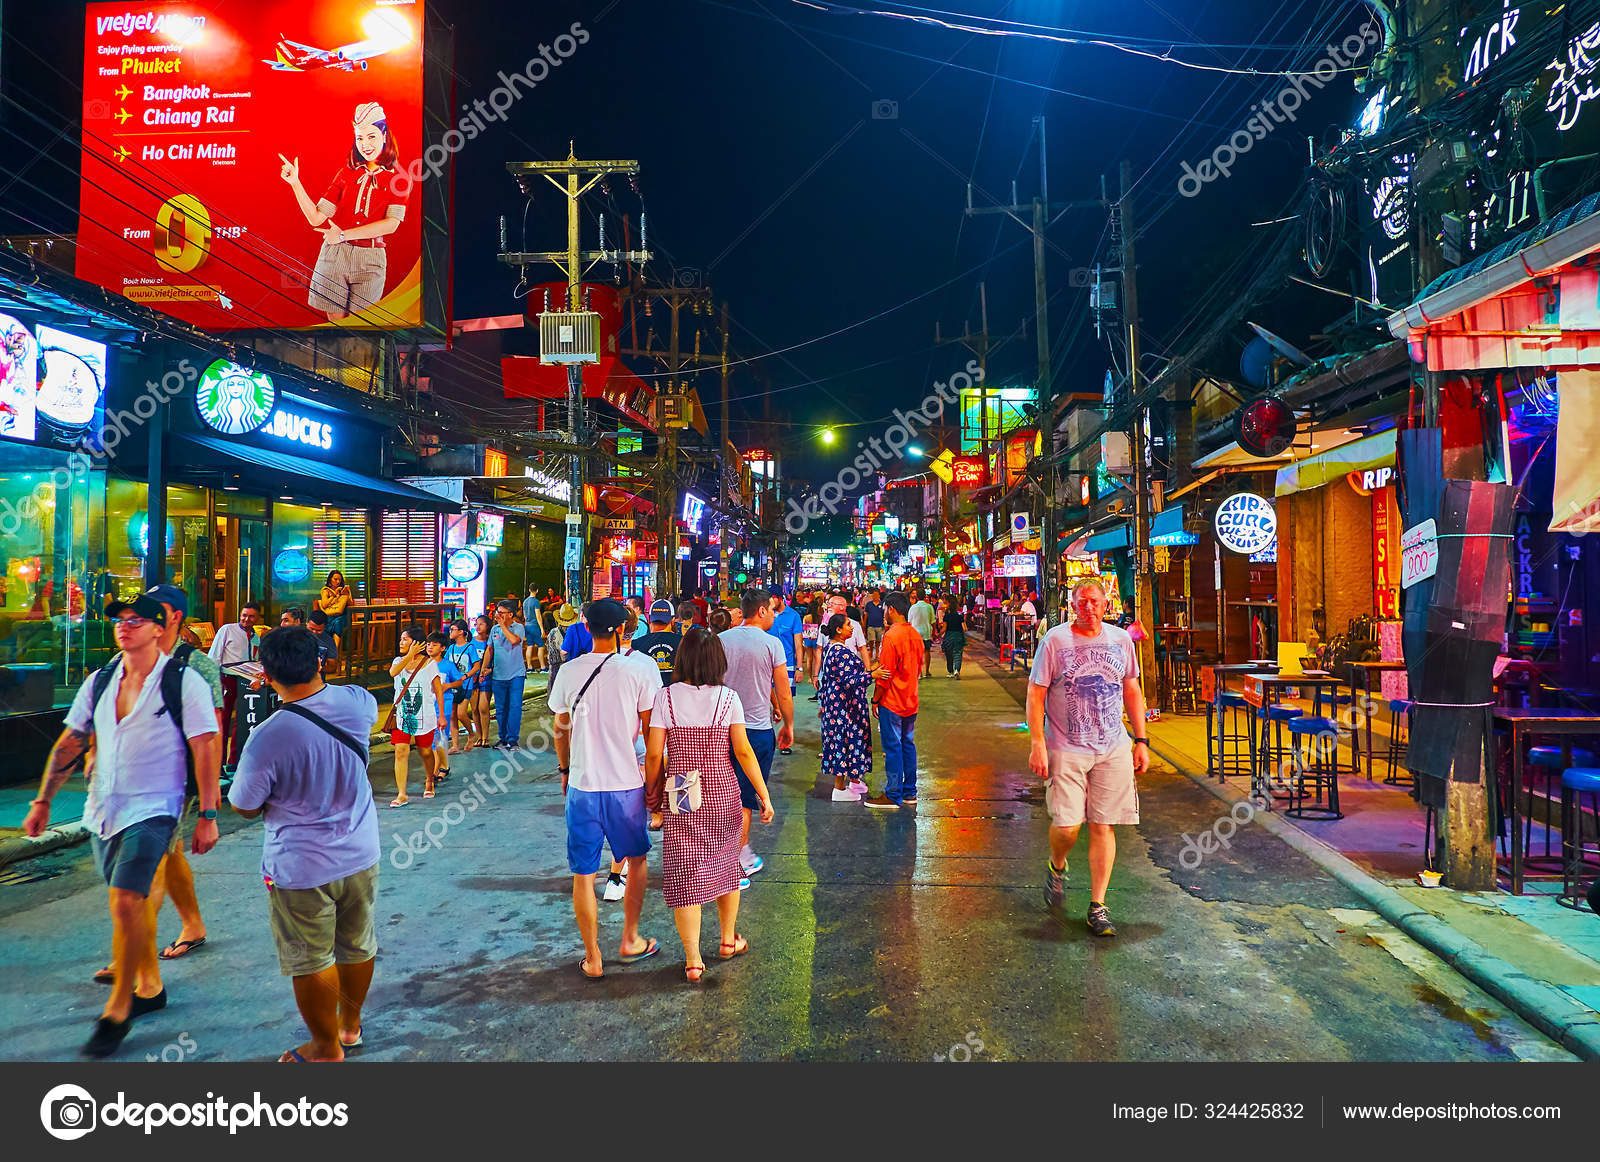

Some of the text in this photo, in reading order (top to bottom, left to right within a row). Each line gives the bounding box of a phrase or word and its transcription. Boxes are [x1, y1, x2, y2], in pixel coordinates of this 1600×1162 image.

[97, 44, 183, 56] Enjoy flying everyday
[99, 57, 182, 76] From Phuket
[143, 84, 211, 103] Bangkok
[143, 105, 236, 128] Chiang Rai
[142, 143, 236, 161] Ho Chi Minh
[123, 227, 151, 239] From
[154, 193, 212, 273] 0
[128, 288, 212, 298] www.vietjetair.com
[1363, 466, 1391, 490] RIP
[1221, 495, 1260, 512] RIP
[607, 520, 629, 528] ATM
[1217, 512, 1274, 534] CURL
